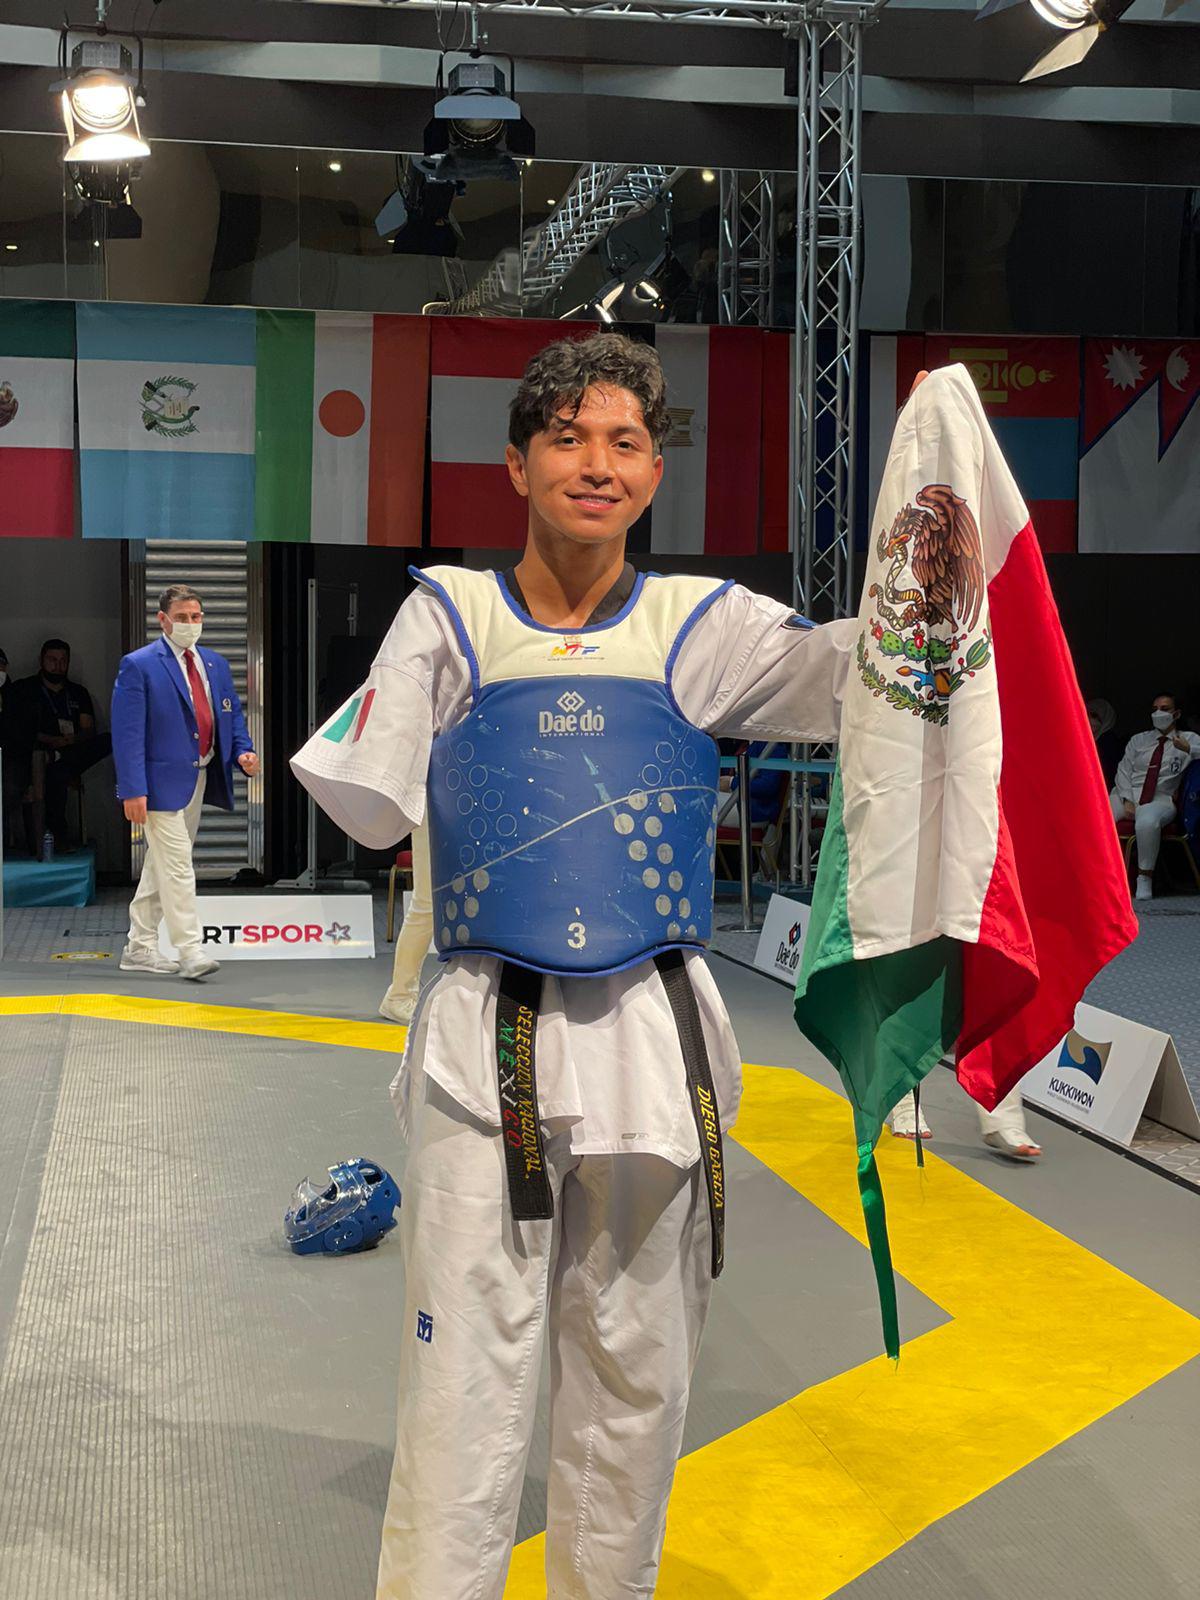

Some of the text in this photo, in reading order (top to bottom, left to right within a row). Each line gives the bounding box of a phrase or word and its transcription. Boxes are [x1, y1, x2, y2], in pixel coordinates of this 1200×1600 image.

[201, 924, 323, 944] RTSPOR
[567, 922, 586, 949] 3
[499, 1017, 523, 1149] MEXICO
[1048, 1077, 1095, 1108] KUKKIWON
[697, 1084, 719, 1145] DIEGO
